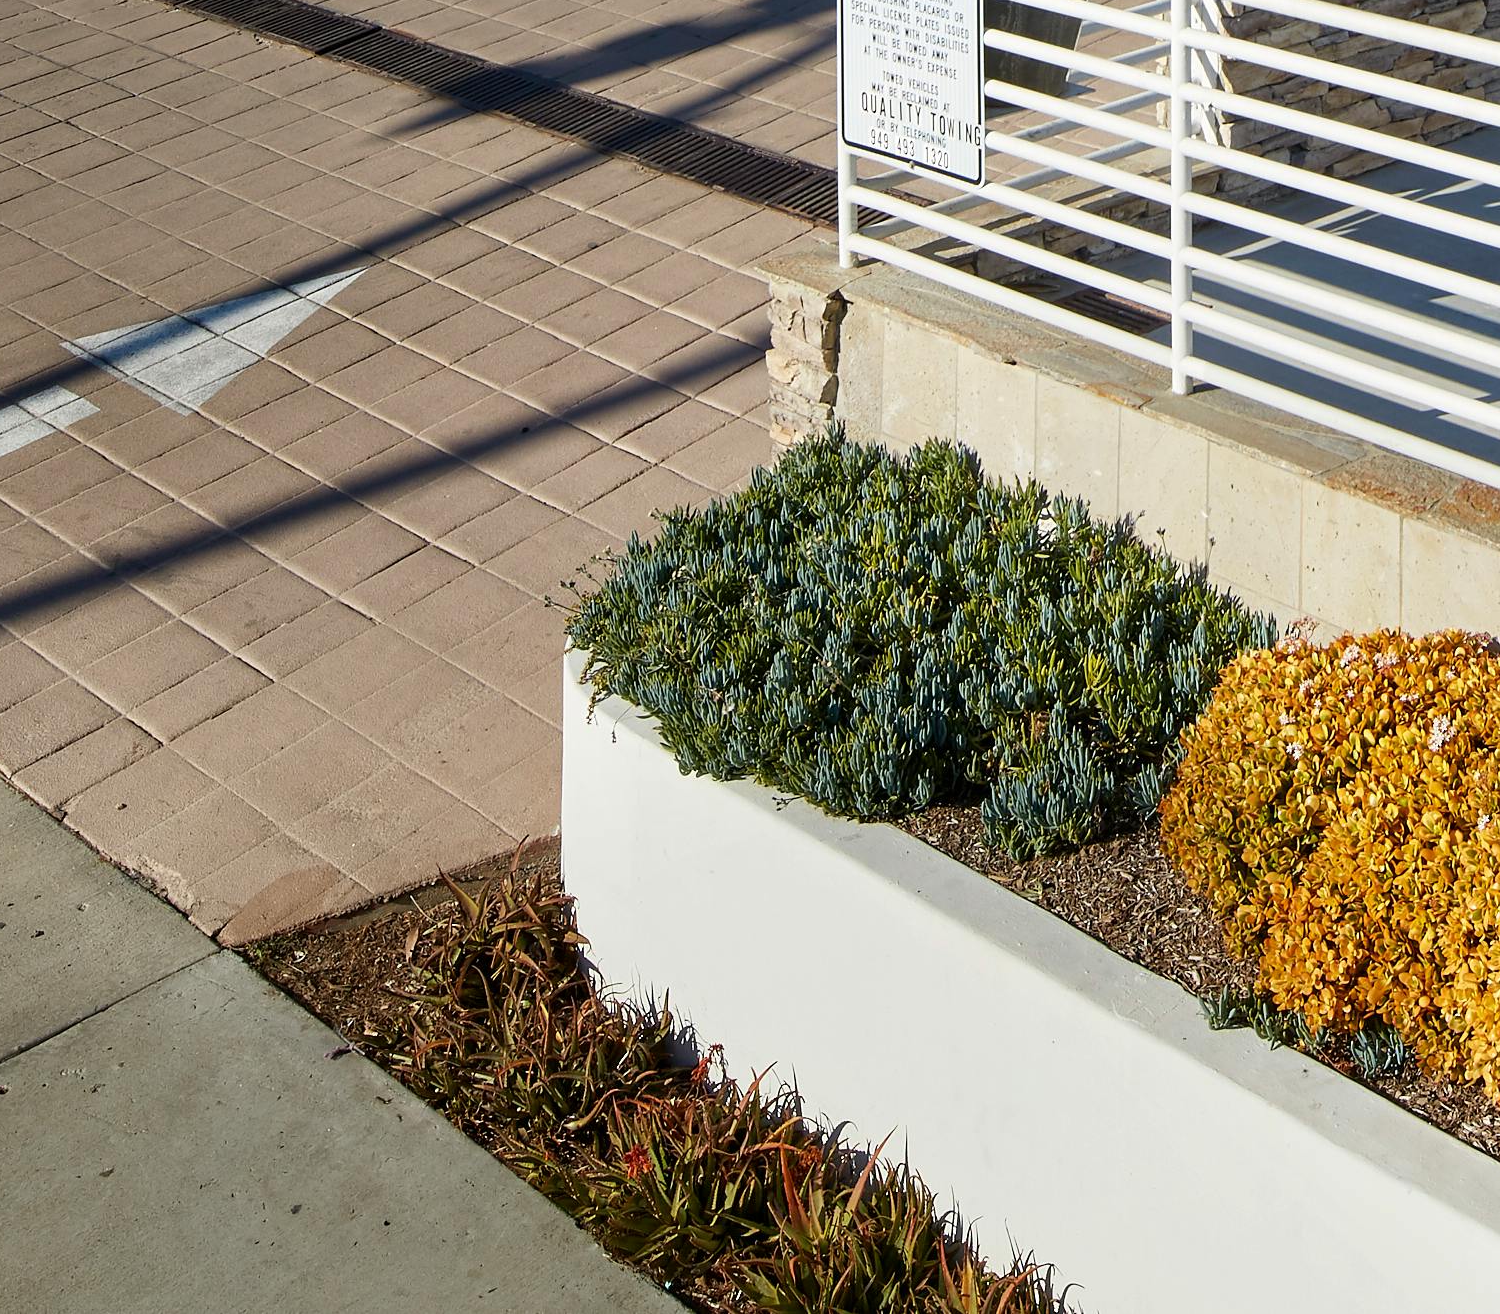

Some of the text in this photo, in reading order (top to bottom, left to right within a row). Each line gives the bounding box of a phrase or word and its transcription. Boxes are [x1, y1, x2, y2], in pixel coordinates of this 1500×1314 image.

[851, 0, 970, 40] SPECIAL LICENSE PLATES ISSUED
[915, 1, 949, 20] PLACARDS
[955, 11, 964, 24] OR
[851, 13, 969, 54] FOR PERSONS WITH DISABILITIES
[872, 32, 948, 63] WILL BE TOWED AWAY
[863, 44, 957, 80] AT THE OWNER'S EXPENSE
[872, 82, 950, 113] MAY BE RECLAIMED AT
[883, 71, 939, 96] TOWED VEHICLES
[861, 91, 981, 146] QUALITY TOWING
[876, 118, 947, 148] OR BY TELEPHONING
[871, 129, 949, 169] 949 493 1320
